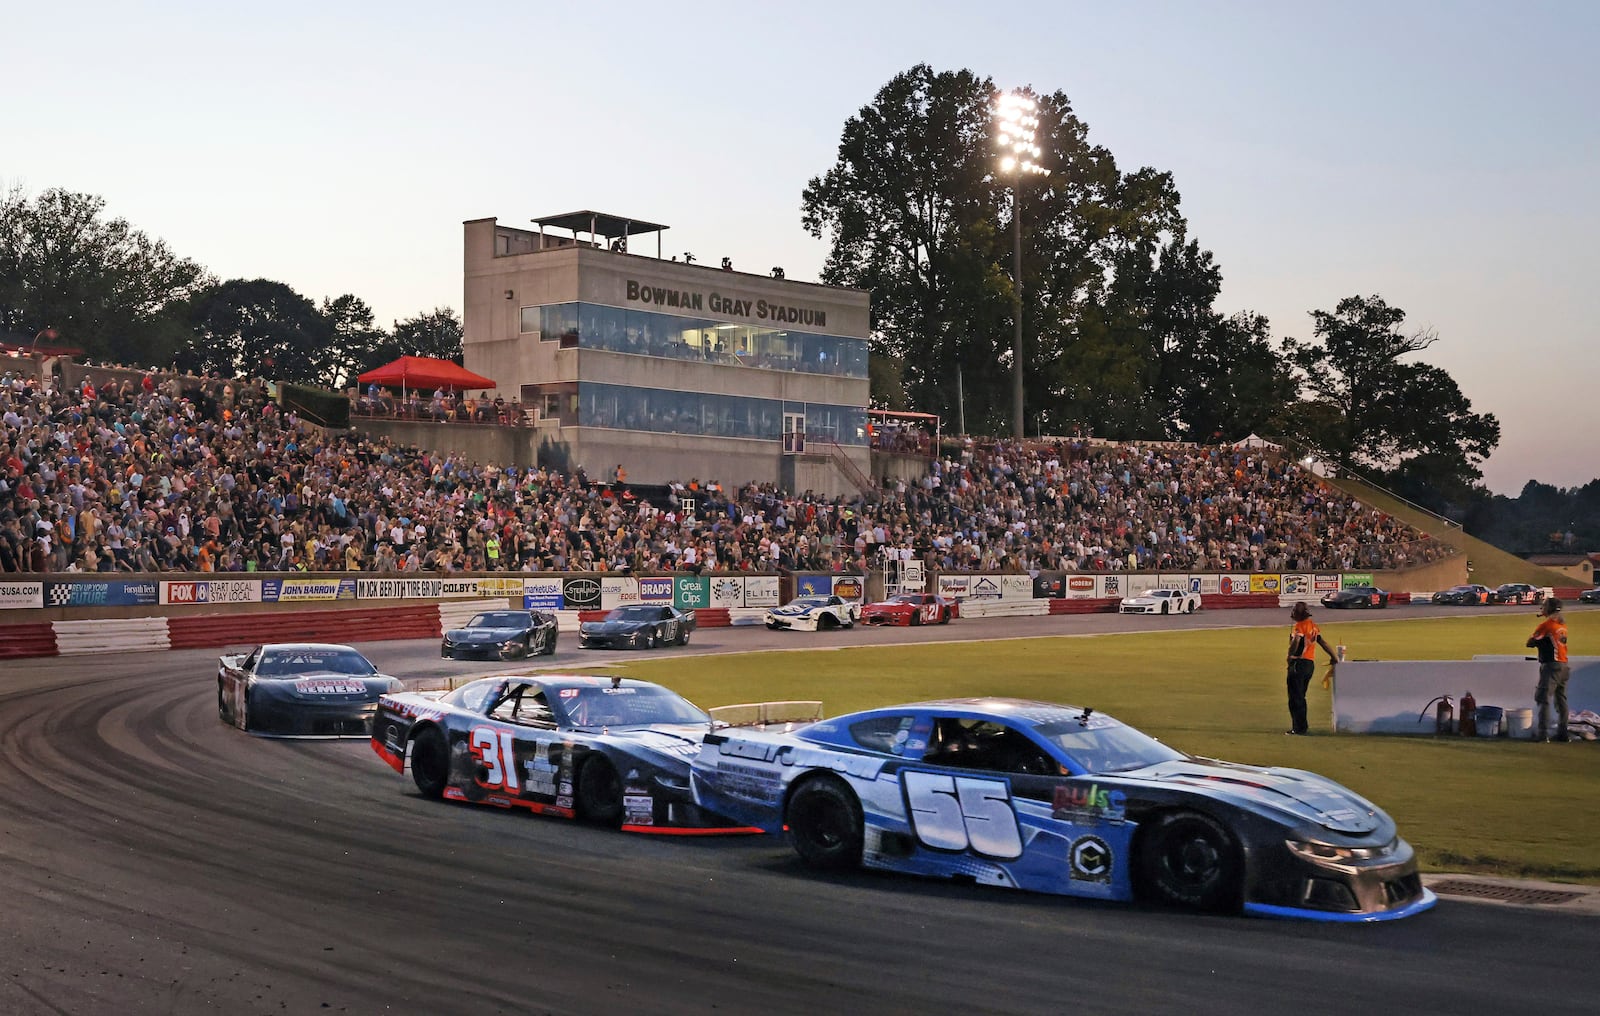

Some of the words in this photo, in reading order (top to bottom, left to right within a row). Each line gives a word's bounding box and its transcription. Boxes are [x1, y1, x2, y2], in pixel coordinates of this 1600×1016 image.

[627, 280, 702, 310] BOWMAN
[709, 293, 752, 317] GRAY
[757, 300, 826, 326] STADIUM
[124, 584, 143, 594] Forsyth
[143, 584, 155, 593] Tech
[210, 582, 229, 592] START
[282, 586, 302, 595] JOHN
[303, 585, 337, 594] BARROW
[407, 581, 420, 596] TIRE
[443, 583, 477, 593] COLBY'S
[642, 584, 671, 595] BRAD'S
[680, 580, 702, 591] Great
[70, 592, 107, 603] FUTURE
[171, 585, 193, 601] FOX
[199, 584, 206, 600] 8
[212, 592, 228, 601] STAY
[681, 592, 700, 606] Clips
[1177, 598, 1184, 611] 7
[928, 604, 939, 620] 21
[560, 688, 579, 698] 31
[471, 725, 520, 794] 31
[902, 769, 1024, 862] 55
